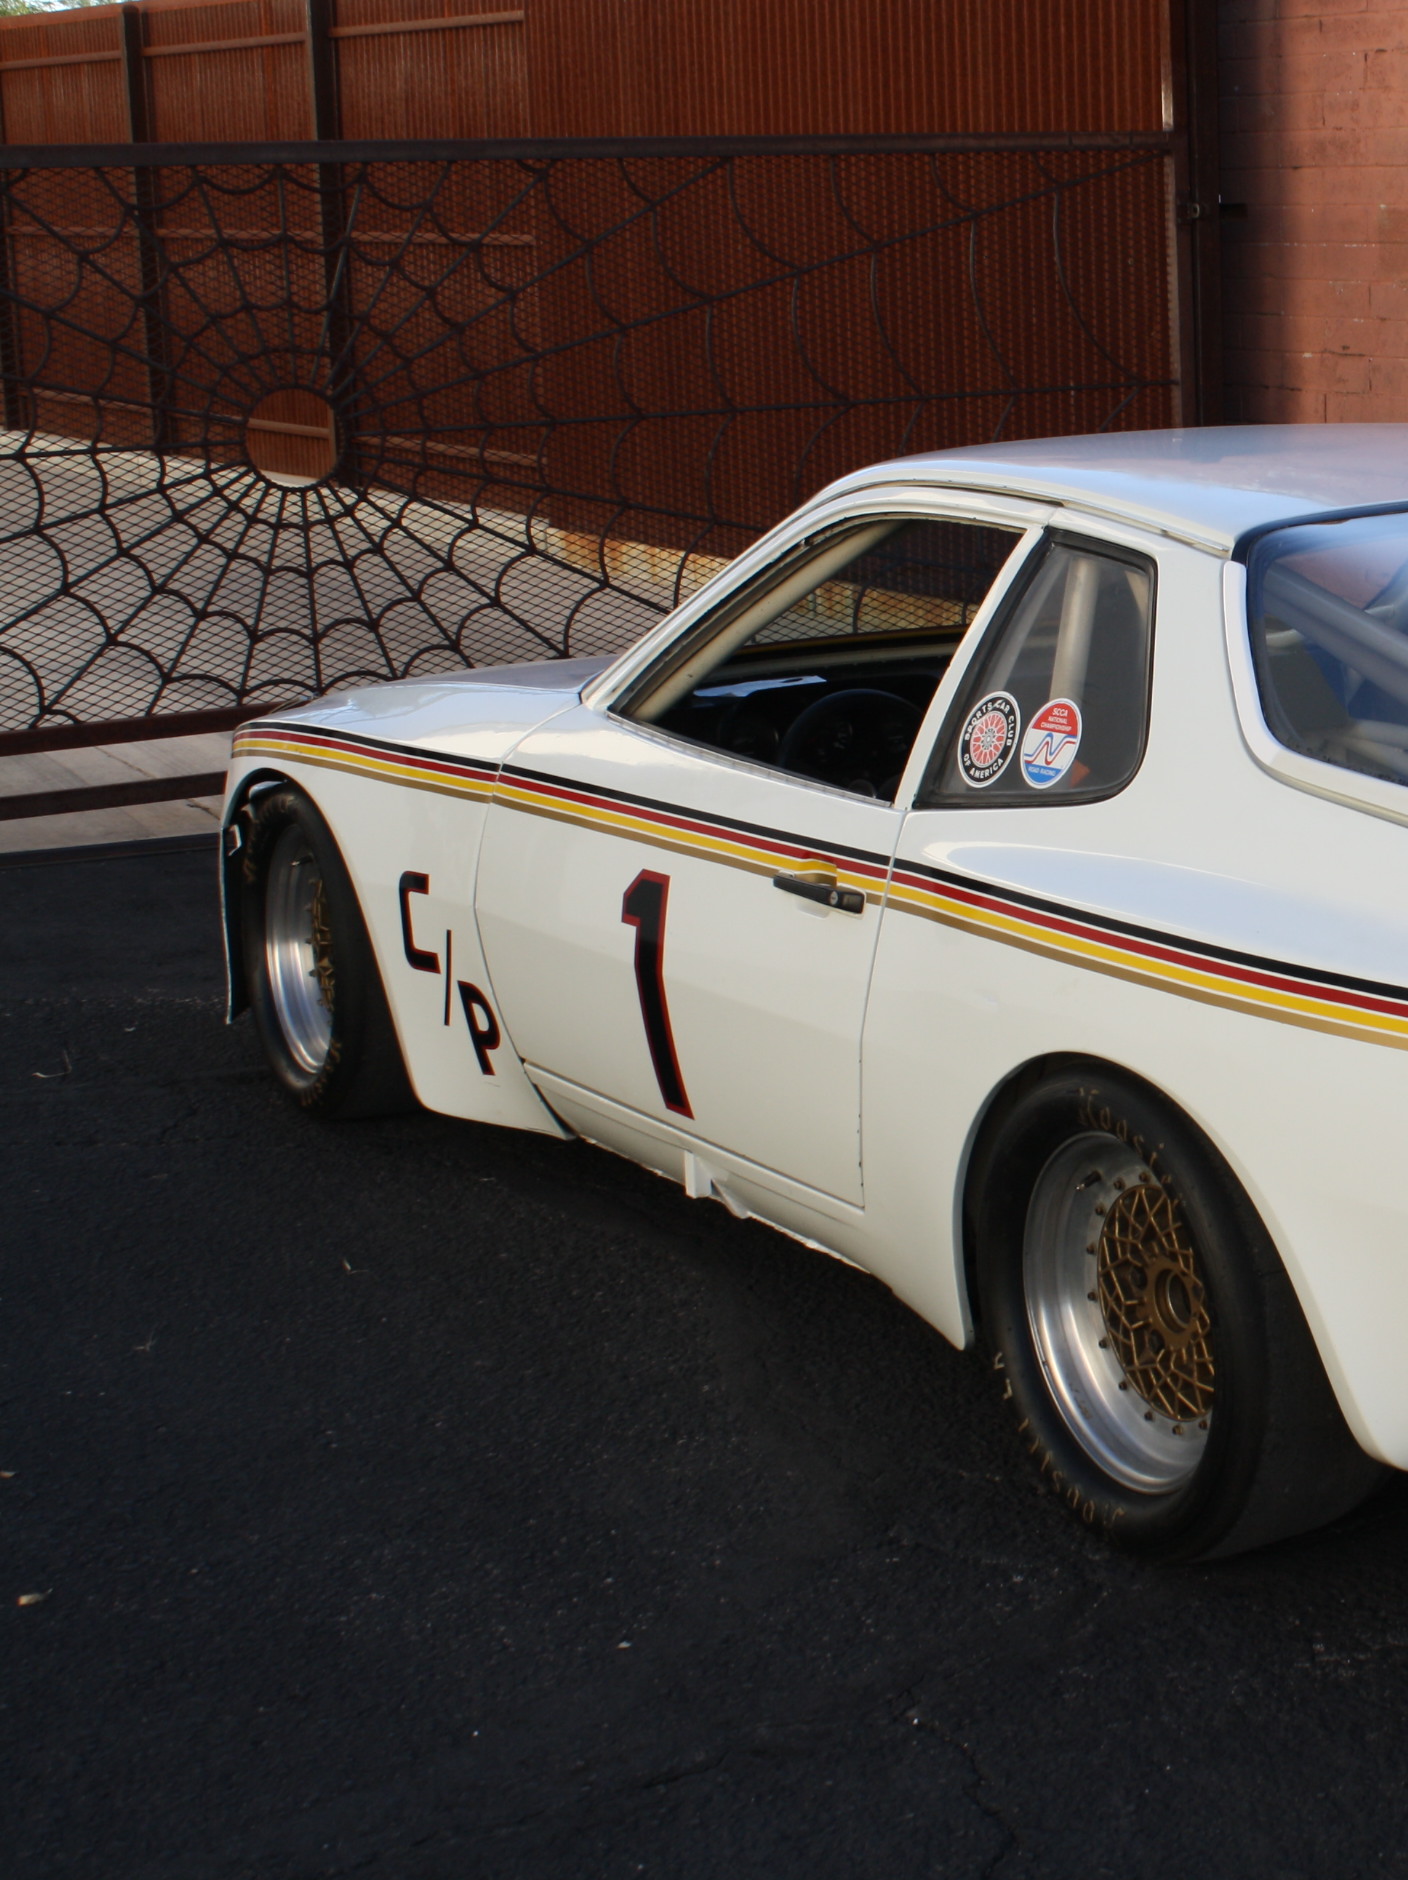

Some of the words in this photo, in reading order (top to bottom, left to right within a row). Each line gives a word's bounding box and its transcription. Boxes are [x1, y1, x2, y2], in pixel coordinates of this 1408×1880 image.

[965, 701, 992, 740] SPORTS
[1006, 715, 1015, 746] CLUB
[1048, 716, 1067, 724] NATIONAL
[1052, 707, 1068, 716] SCCA
[963, 753, 971, 767] OF
[970, 758, 1003, 778] AMERICA
[621, 868, 695, 1121] 1
